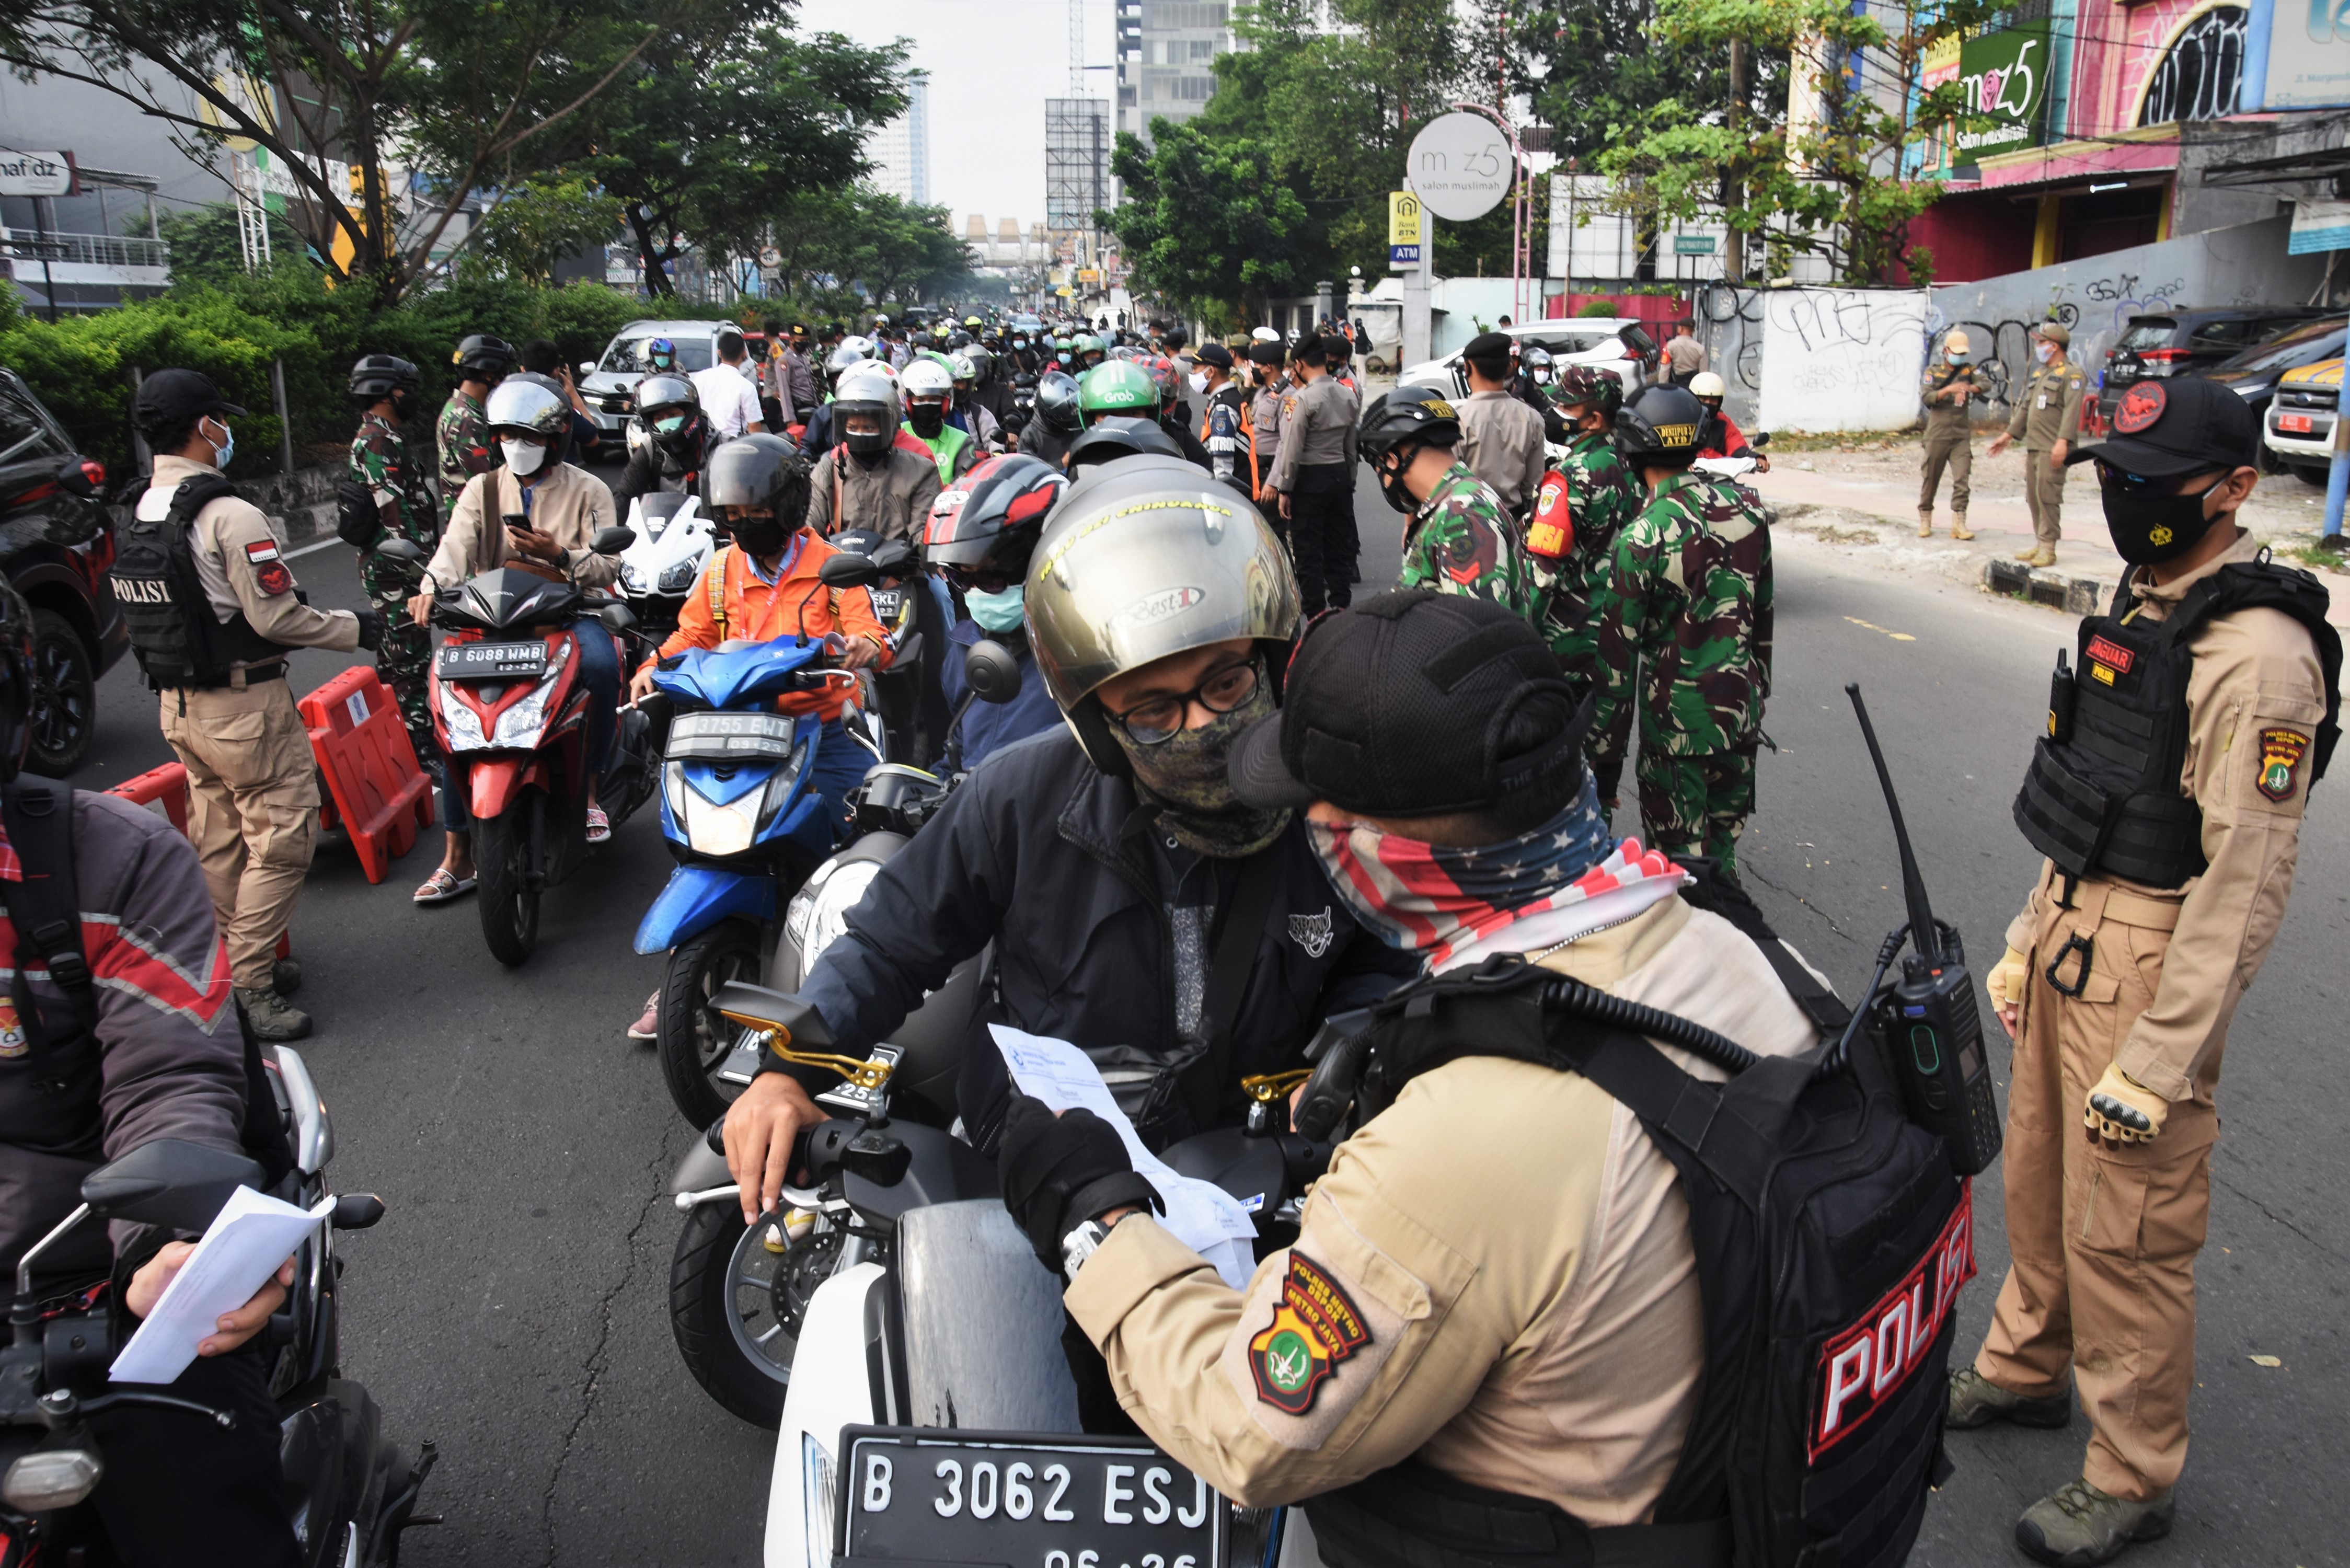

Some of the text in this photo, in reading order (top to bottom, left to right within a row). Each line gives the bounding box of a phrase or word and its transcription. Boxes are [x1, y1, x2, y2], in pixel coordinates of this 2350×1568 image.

[1422, 181, 1500, 190] salon muslimah
[1396, 247, 1418, 259] ATM
[1104, 389, 1135, 403] Grab
[1667, 436, 1687, 445] ATD
[110, 577, 172, 603] POLISI
[448, 647, 540, 663] B 6088 WMB
[2090, 639, 2129, 668] JAGUAR
[2094, 665, 2114, 683] POLISI
[698, 718, 743, 734] 3755
[750, 718, 788, 737] EWT
[1294, 1261, 1359, 1338] POLRES METRO
[1308, 1284, 1341, 1323] DEPOK
[1287, 1288, 1340, 1353] METRO JAYA
[1824, 1204, 1969, 1434] POLISI
[863, 1454, 1207, 1528] B 3062 ESJ
